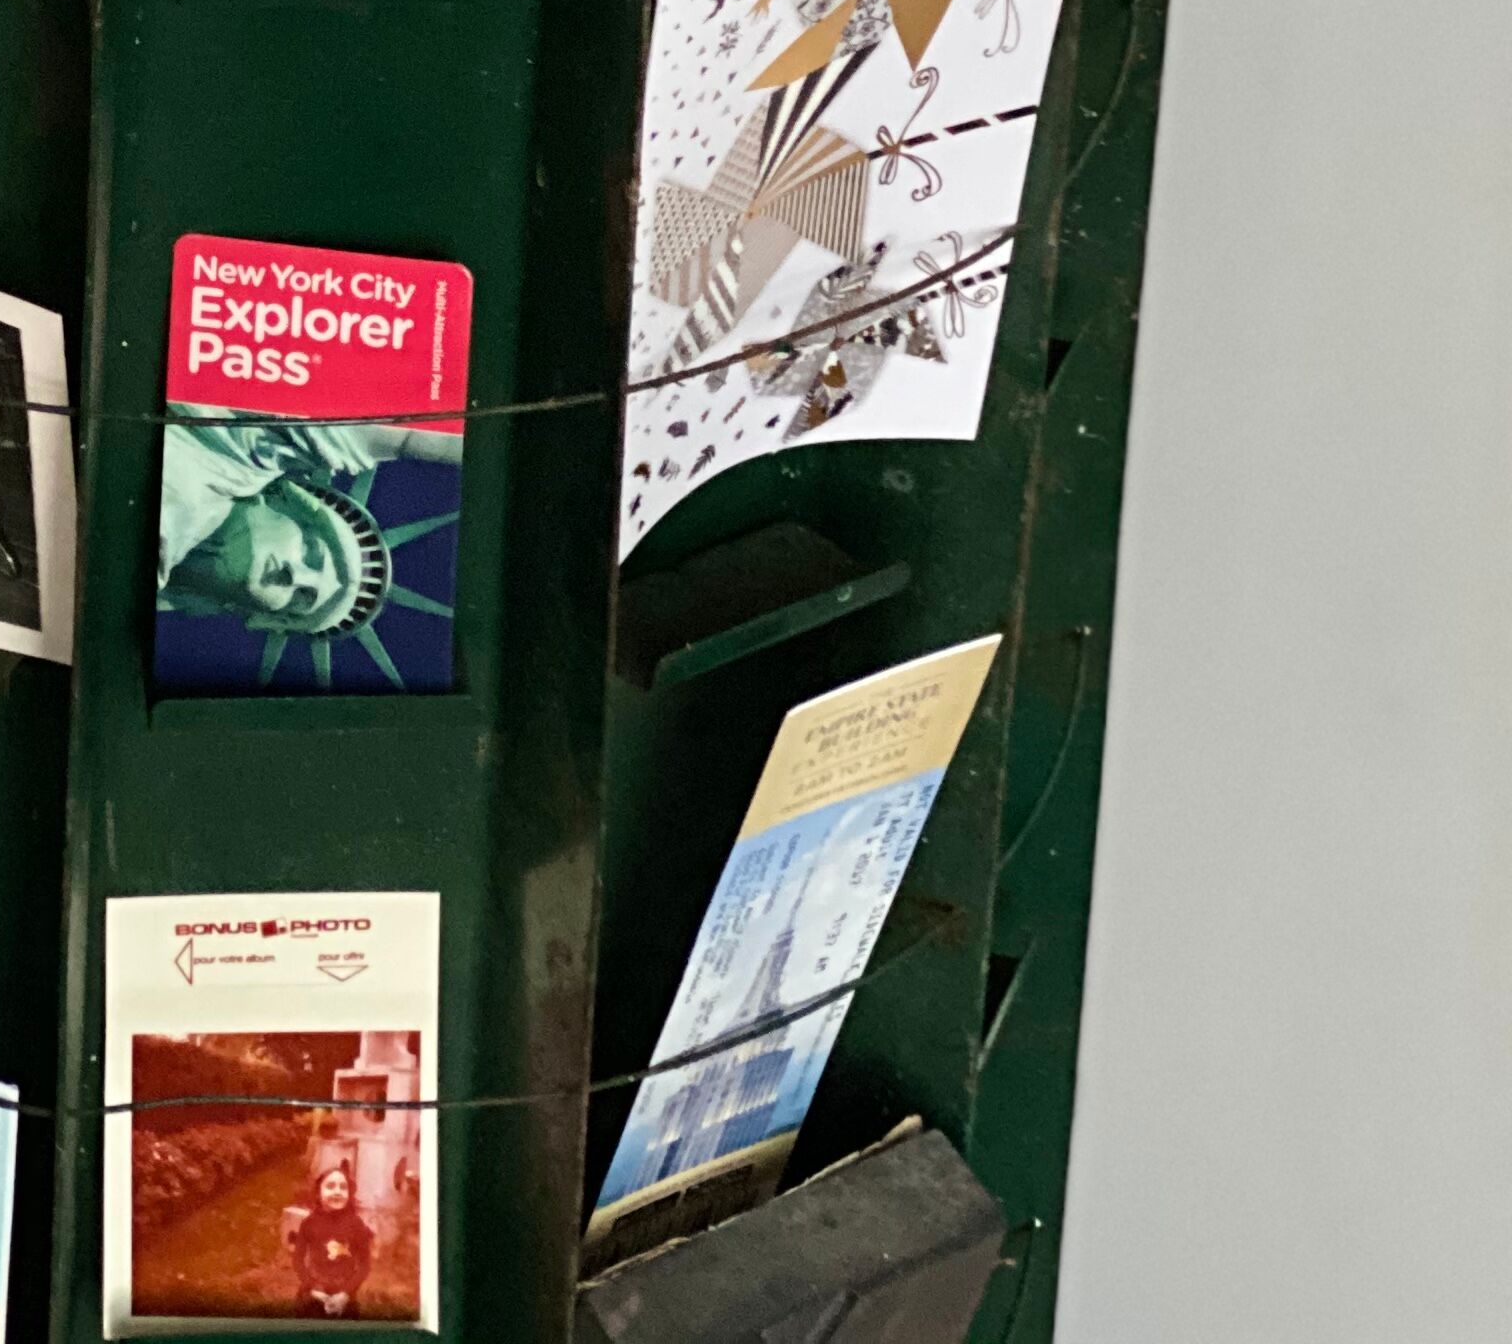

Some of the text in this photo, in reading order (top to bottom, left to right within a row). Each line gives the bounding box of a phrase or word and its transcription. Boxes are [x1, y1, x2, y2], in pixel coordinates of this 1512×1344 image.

[193, 254, 417, 309] New York City
[190, 285, 415, 350] Explorer
[175, 918, 372, 937] BONUS PHOTO
[192, 953, 276, 966] pour votre album
